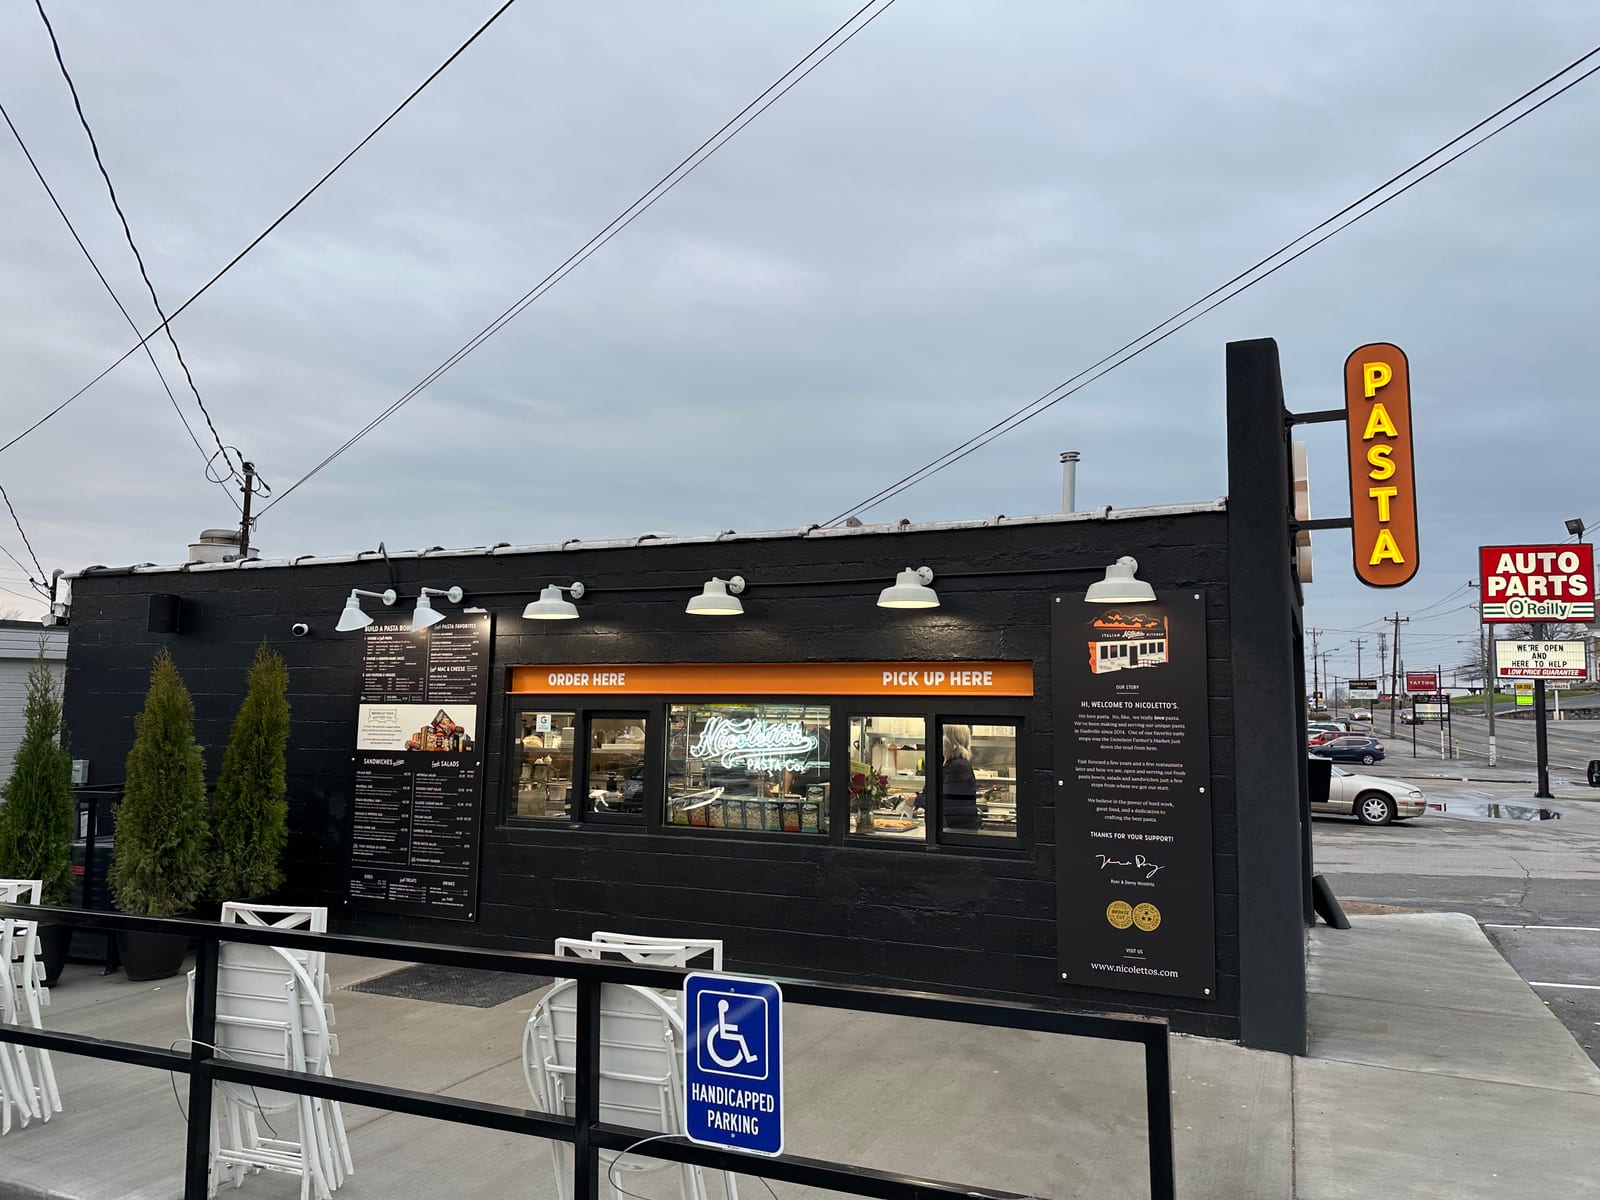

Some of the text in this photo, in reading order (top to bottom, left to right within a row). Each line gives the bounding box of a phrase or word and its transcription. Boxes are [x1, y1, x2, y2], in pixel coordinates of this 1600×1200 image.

[1362, 361, 1405, 565] PASTA
[1496, 551, 1580, 574] AUTO
[1488, 574, 1588, 596] PARTS
[1509, 599, 1567, 616] O'Reilly
[548, 673, 625, 686] ORDER HERE
[882, 671, 993, 686] PICK UP HERE
[747, 759, 781, 771] PASTA
[1091, 962, 1178, 977] www.nicolettos.com
[692, 1082, 774, 1113] HANDICAPPED
[707, 1109, 759, 1136] PARKING
